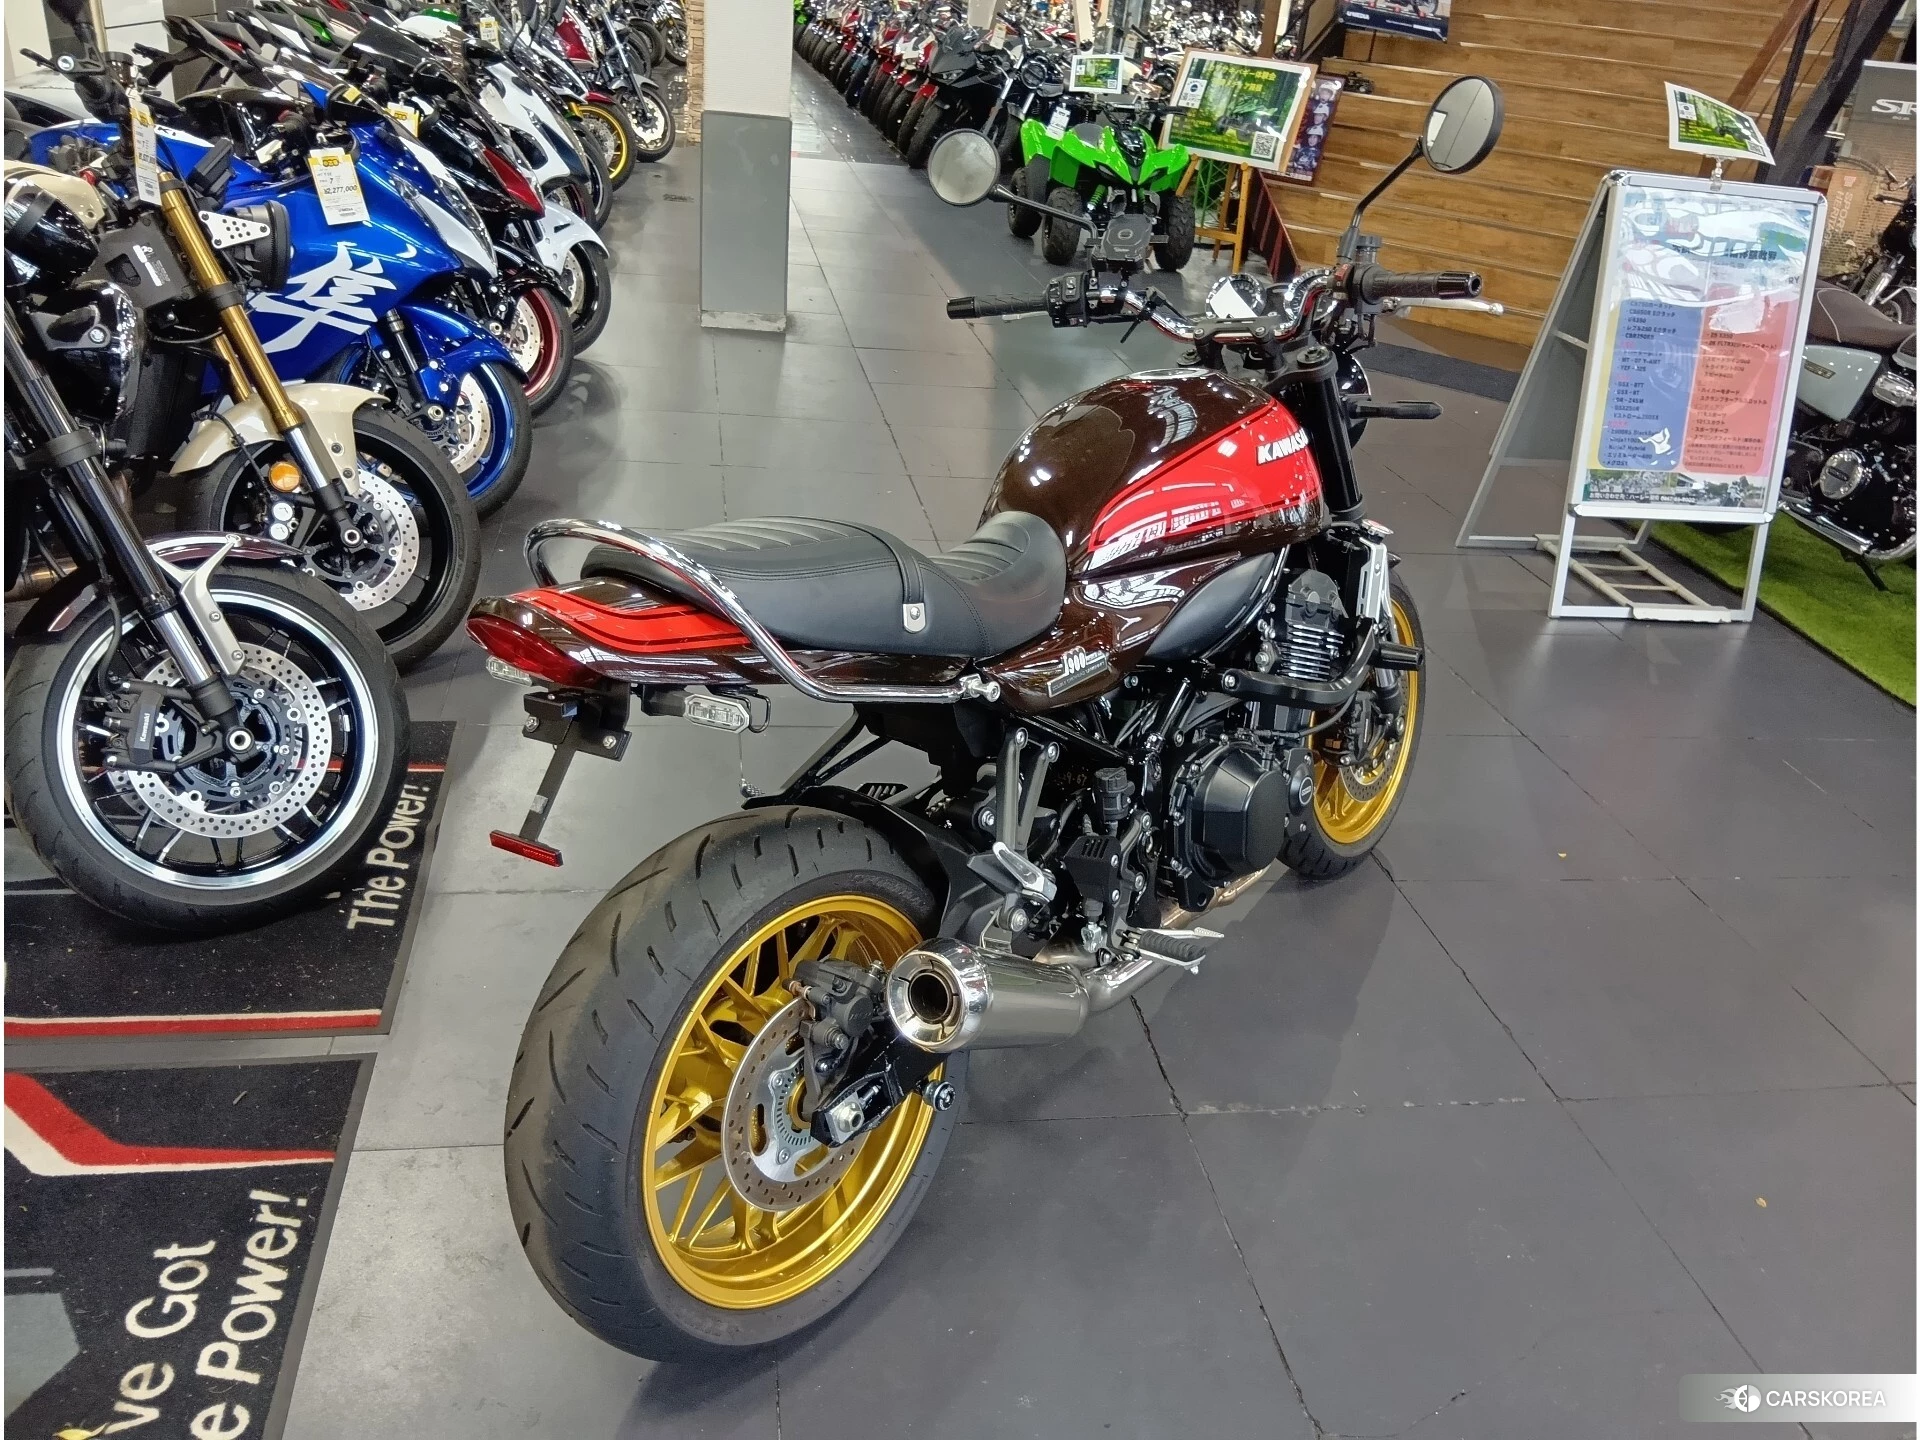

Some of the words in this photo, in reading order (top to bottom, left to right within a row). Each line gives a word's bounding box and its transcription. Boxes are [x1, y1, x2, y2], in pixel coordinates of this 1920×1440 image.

[139, 712, 151, 742] Kawasaki
[366, 783, 431, 870] Power!
[346, 875, 406, 930] The
[125, 1239, 217, 1339] Got
[195, 1189, 308, 1386] Power!
